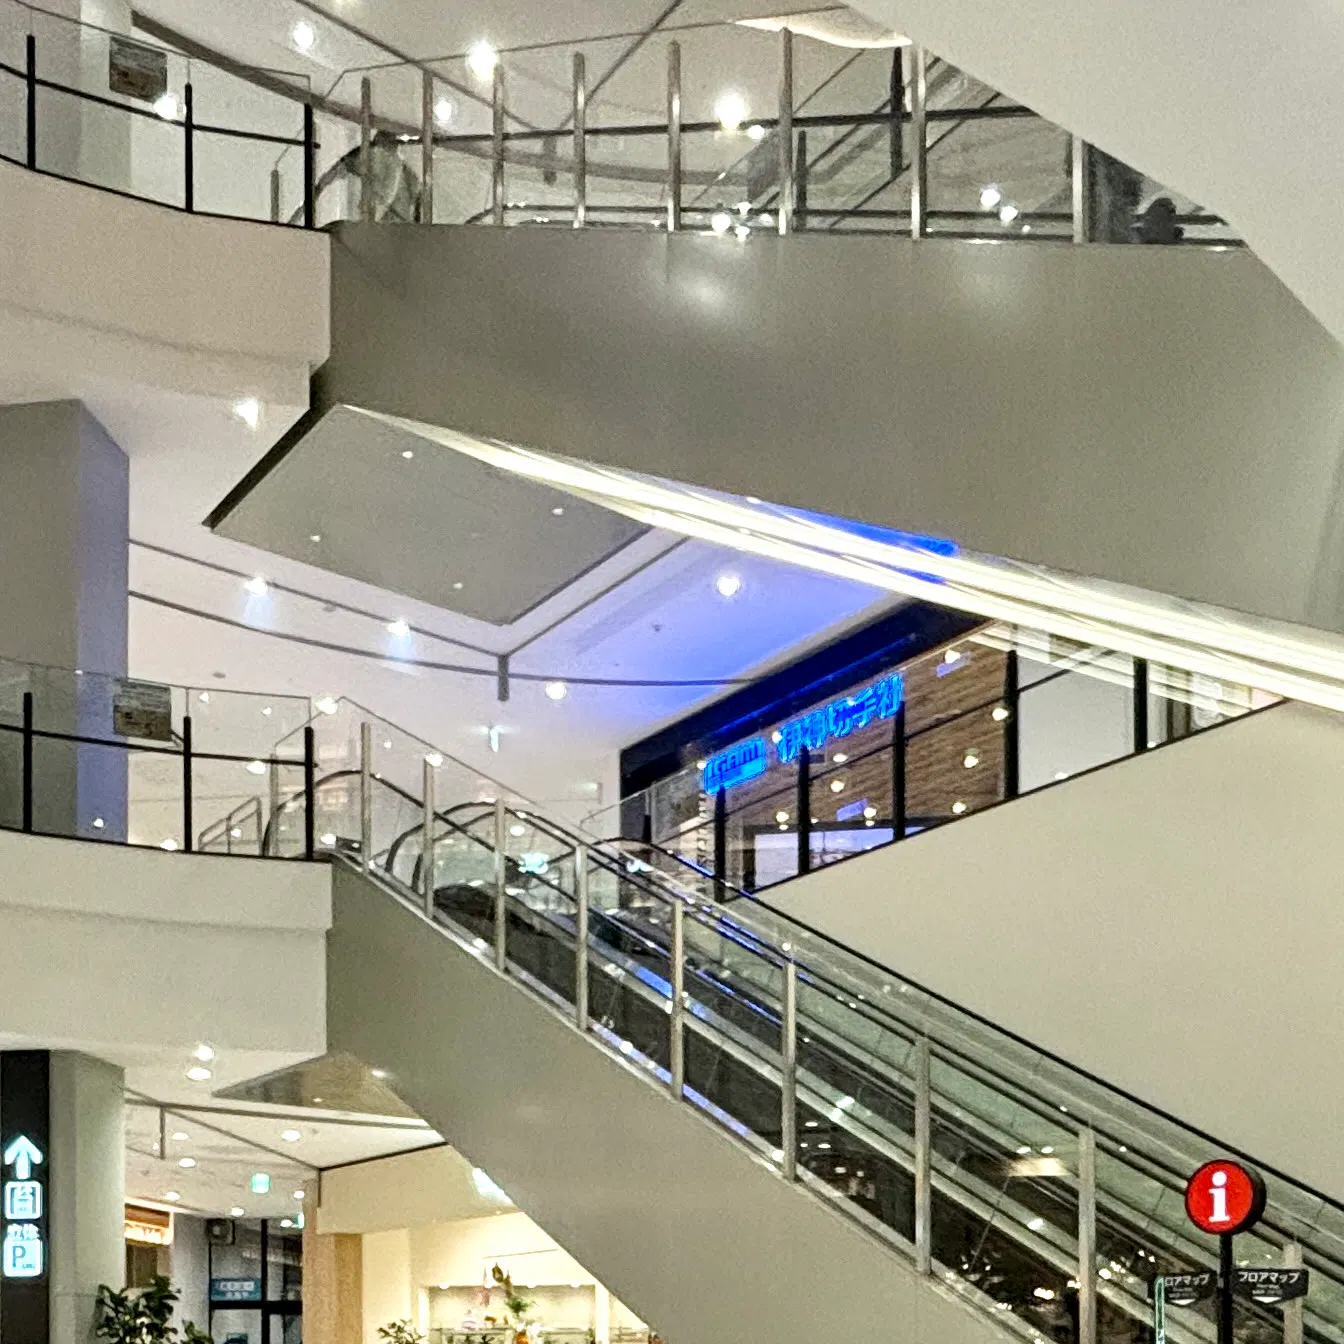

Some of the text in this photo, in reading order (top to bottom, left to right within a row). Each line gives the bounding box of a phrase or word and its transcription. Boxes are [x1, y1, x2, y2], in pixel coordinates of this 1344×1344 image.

[1208, 1171, 1231, 1222] i
[12, 1245, 26, 1267] P
[1164, 1273, 1210, 1286] ロアマップ
[1238, 1271, 1300, 1284] フロアマップ
